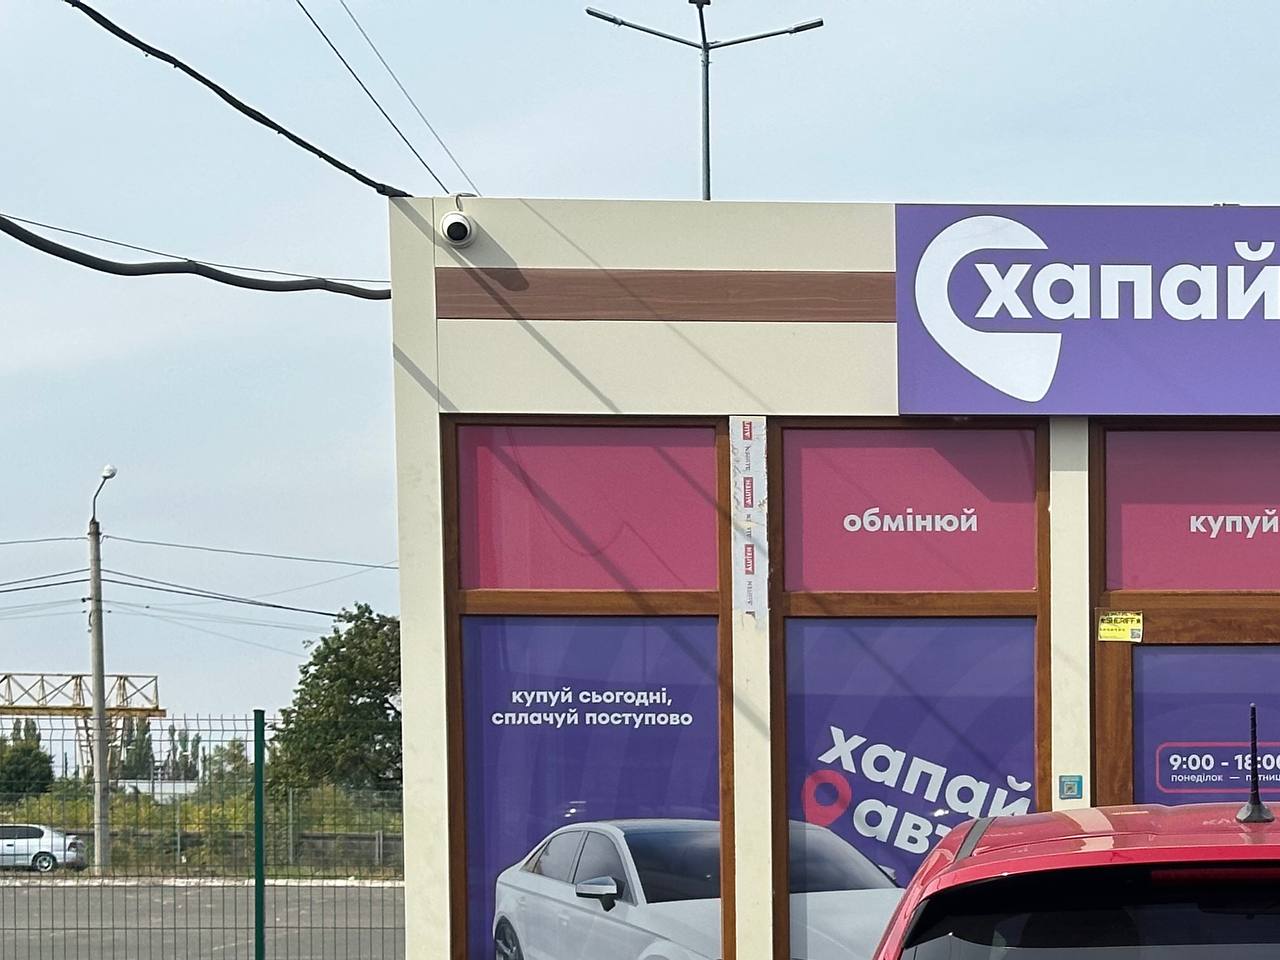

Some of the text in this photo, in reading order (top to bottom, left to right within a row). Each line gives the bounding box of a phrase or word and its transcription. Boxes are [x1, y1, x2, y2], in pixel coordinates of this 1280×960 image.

[843, 507, 978, 533] обмінюй
[1189, 509, 1279, 540] купуй
[512, 687, 672, 707] купуй сьогодні,
[491, 708, 693, 728] сплачуй поступово
[817, 725, 1032, 818] хапай
[1169, 754, 1215, 770] 9:00
[1171, 773, 1223, 783] понеділок
[853, 798, 952, 854] ав
